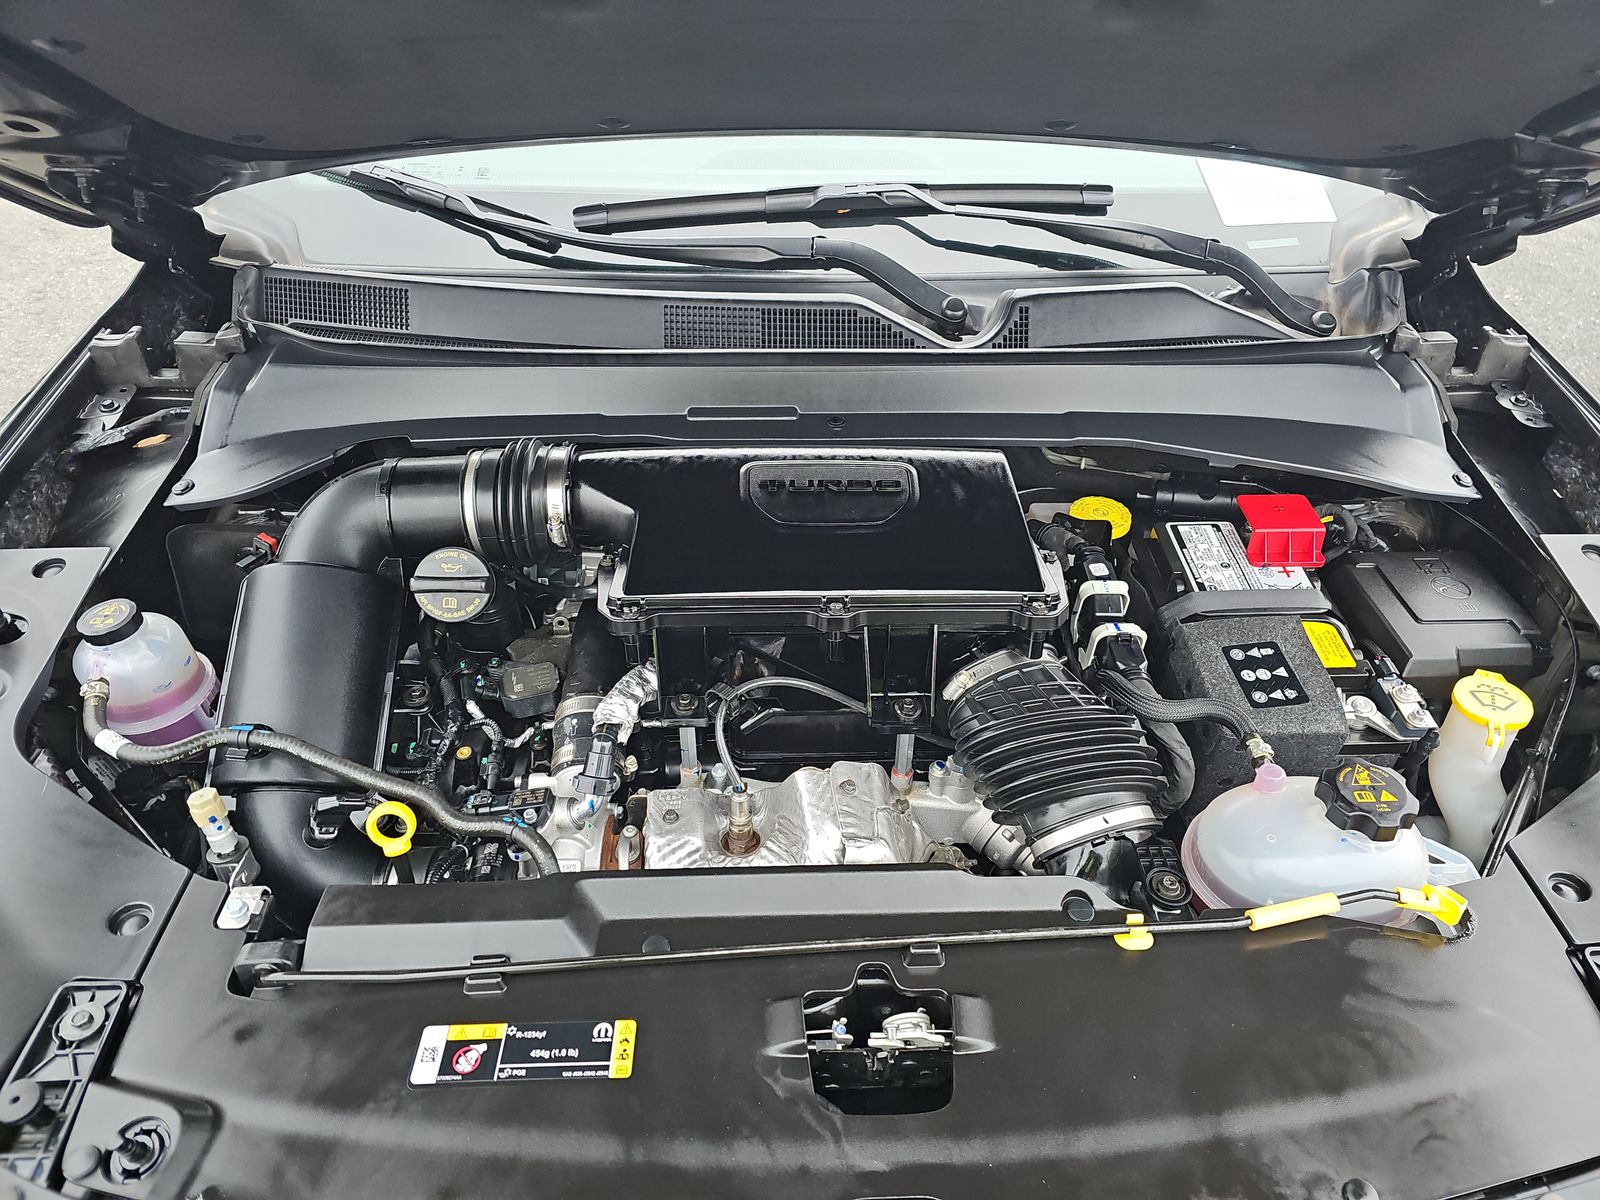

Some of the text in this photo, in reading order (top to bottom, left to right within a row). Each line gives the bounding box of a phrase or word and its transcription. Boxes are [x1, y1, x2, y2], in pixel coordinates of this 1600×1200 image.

[758, 479, 902, 492] TURBO
[435, 552, 469, 561] ENGINE OIL
[515, 1030, 547, 1039] R-1234yf
[530, 1048, 579, 1059] 454g (1.0 lb)
